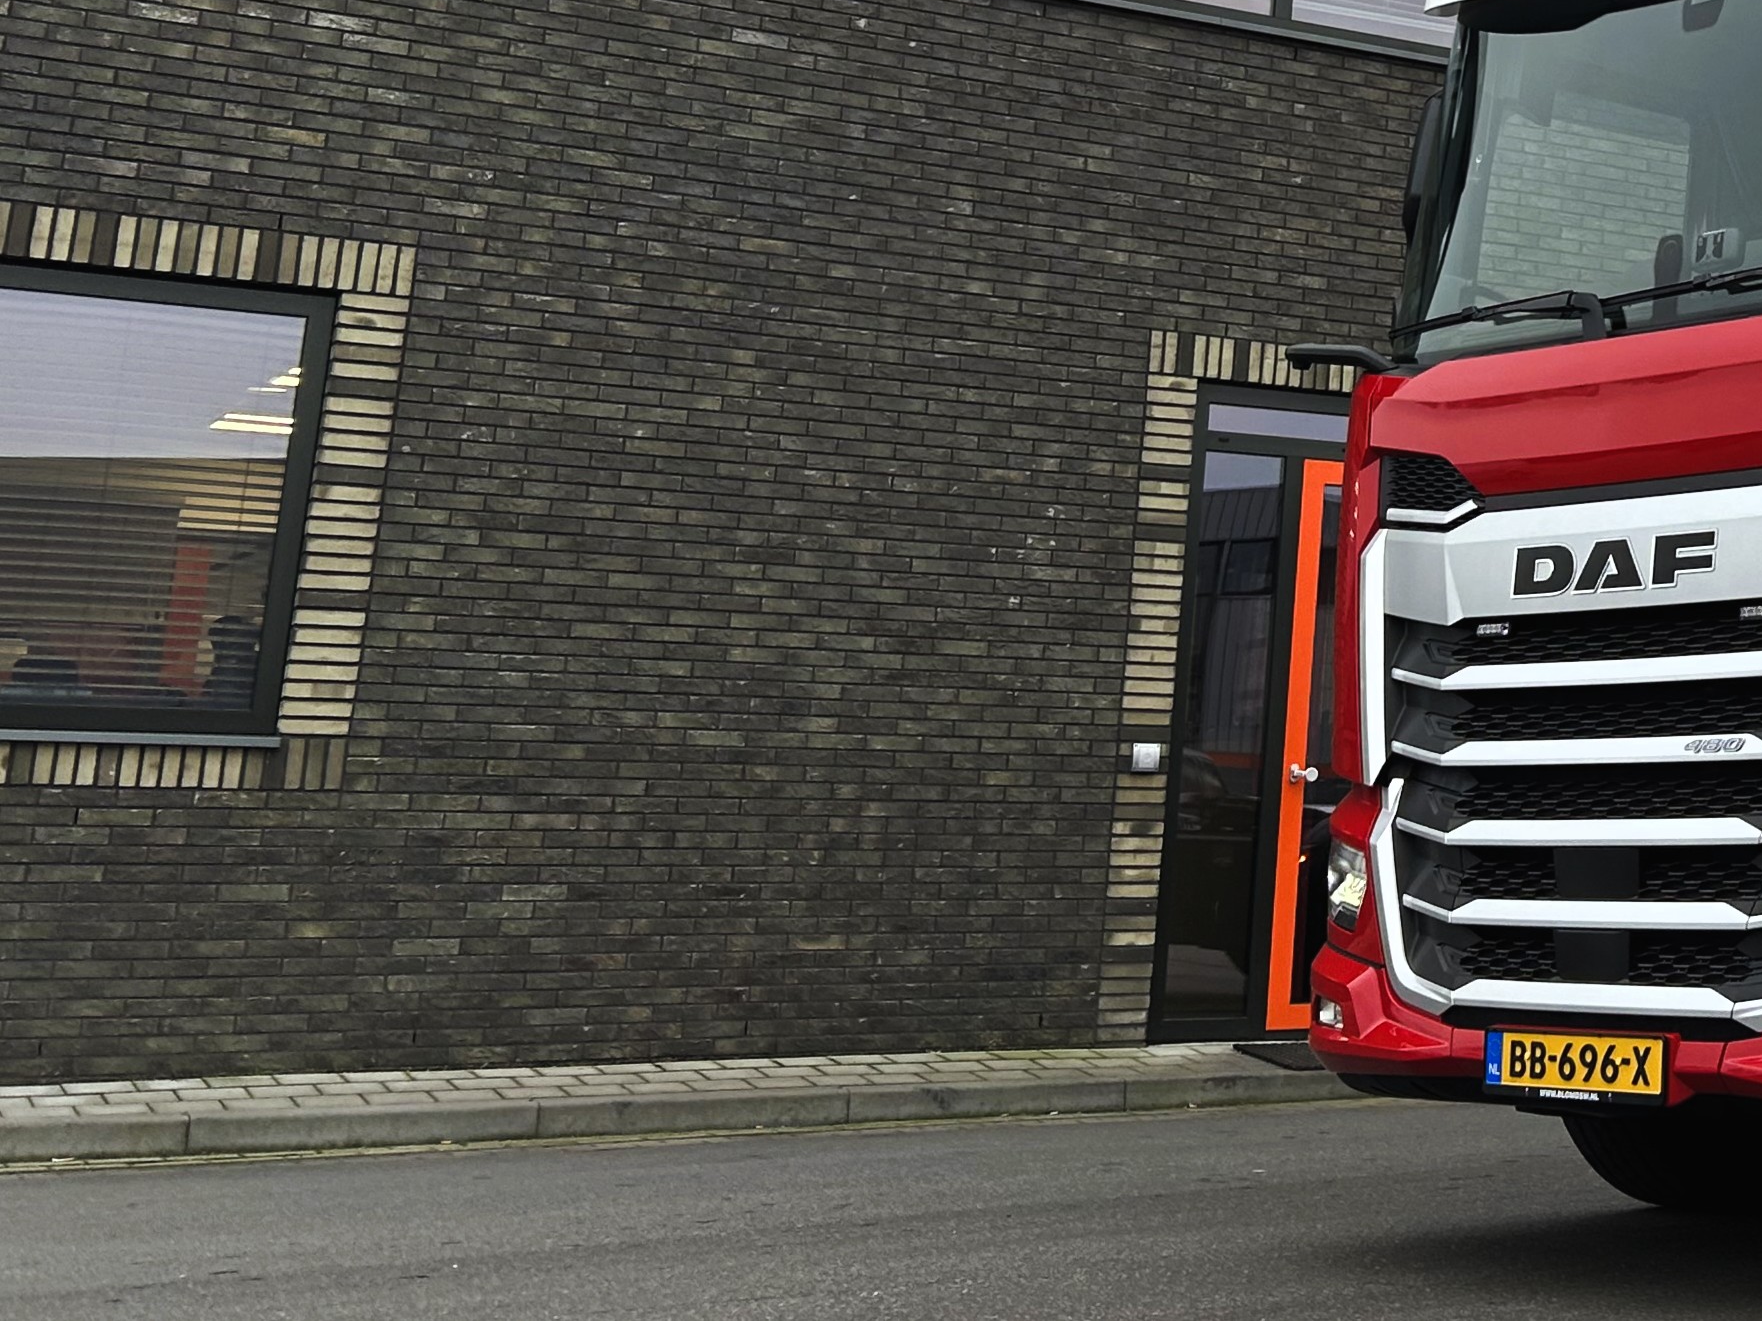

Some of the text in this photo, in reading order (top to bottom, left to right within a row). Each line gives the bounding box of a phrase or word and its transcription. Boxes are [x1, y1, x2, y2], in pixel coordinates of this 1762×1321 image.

[1511, 528, 1718, 599] DAF
[1488, 1062, 1501, 1076] NL
[1509, 1039, 1652, 1087] BB-696-X
